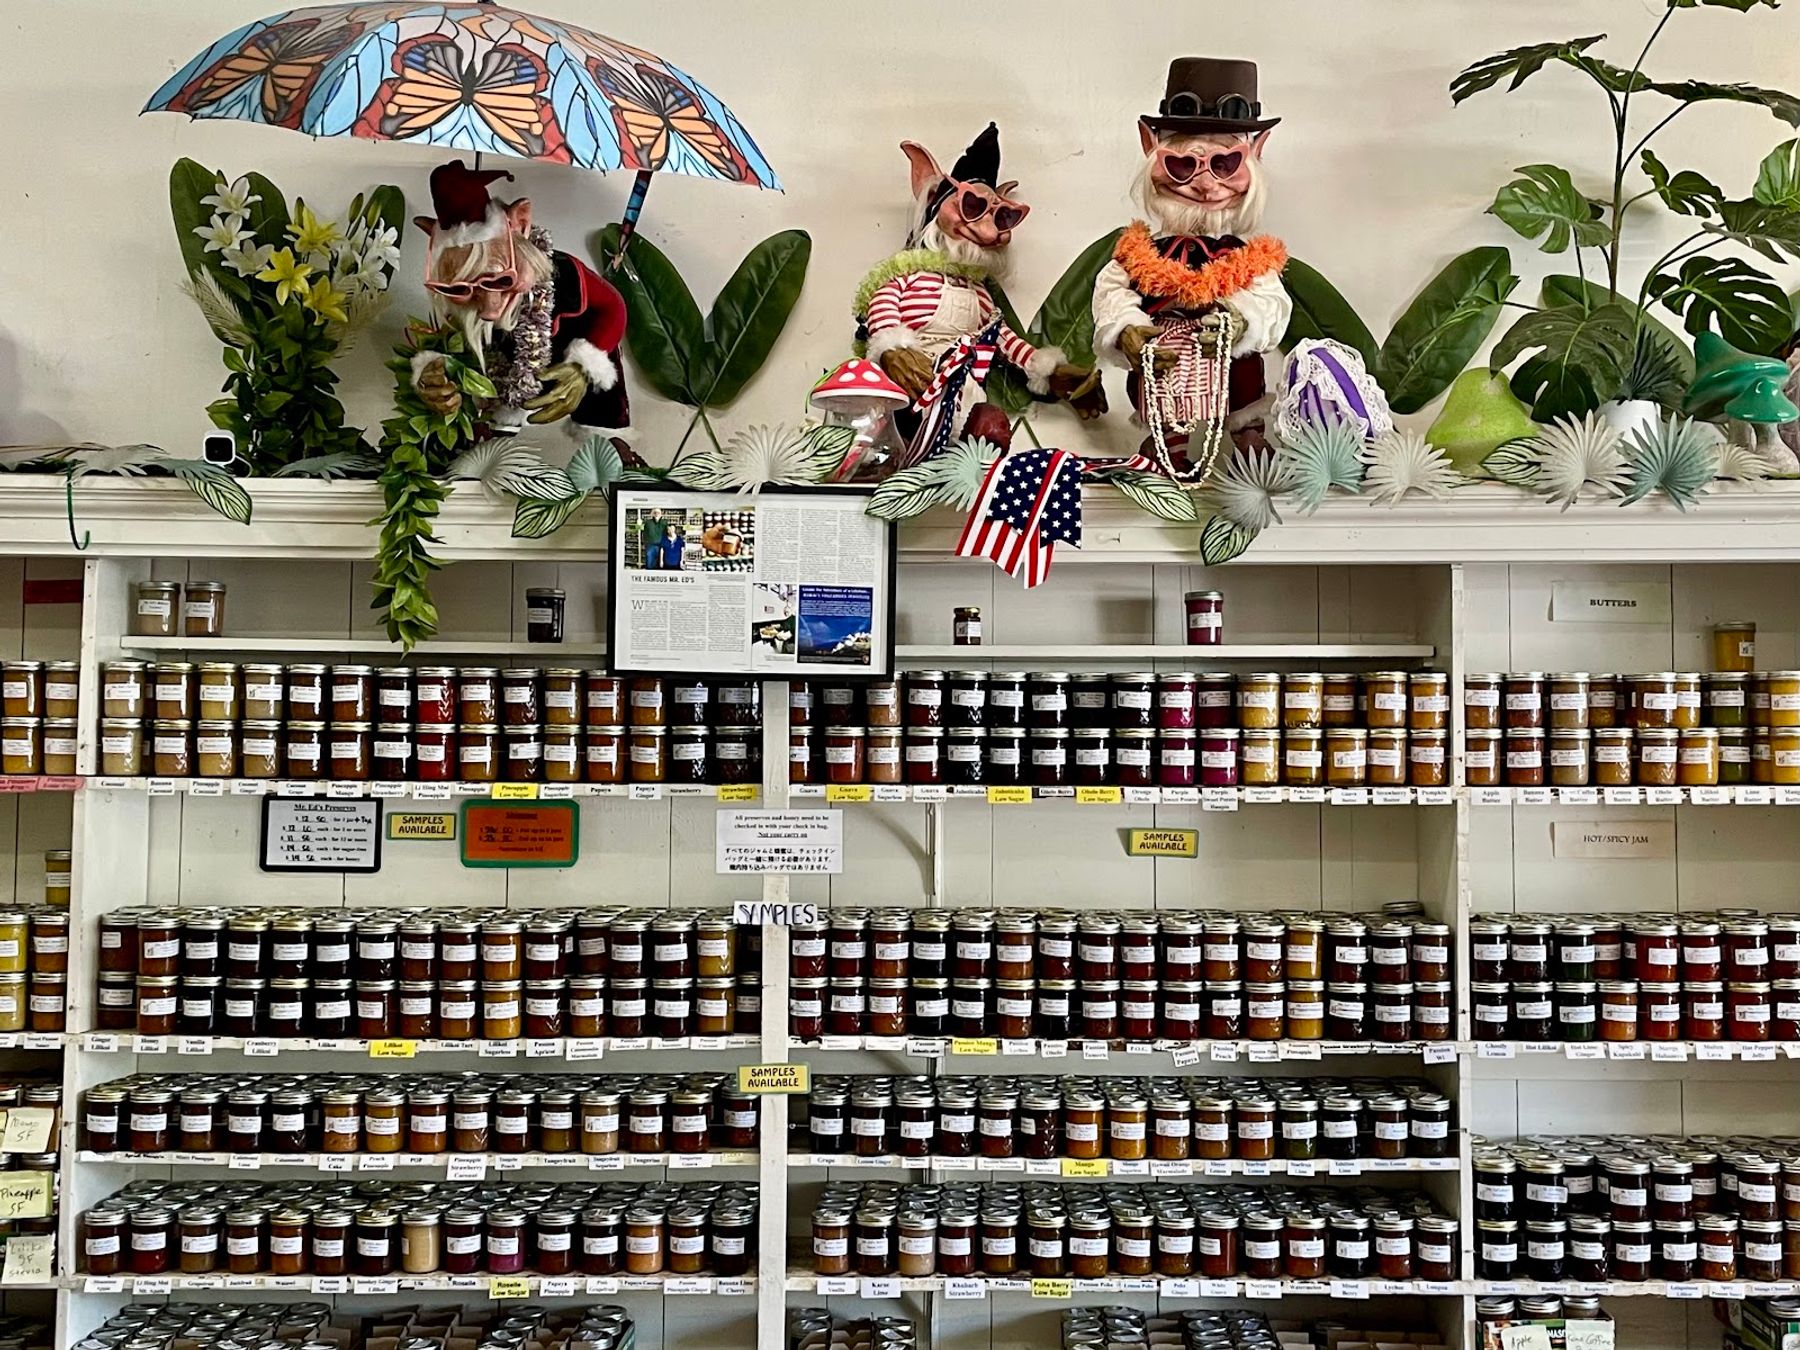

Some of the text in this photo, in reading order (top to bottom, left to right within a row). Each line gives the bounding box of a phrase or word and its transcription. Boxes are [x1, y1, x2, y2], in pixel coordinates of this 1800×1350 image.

[1590, 599, 1637, 607] BUTTERS
[402, 816, 443, 824] SAMPLES
[399, 825, 447, 834] AVAILABLE
[1143, 833, 1184, 841] SAMPLES
[1583, 835, 1648, 845] HOT/SPICY JAM
[1139, 841, 1187, 851] AVAILABLE
[751, 1067, 795, 1077] SAMPLES
[748, 1078, 799, 1087] AVAILABLE
[16, 1130, 35, 1142] SF
[9, 1201, 25, 1216] SF
[1511, 1335, 1533, 1348] Apple
